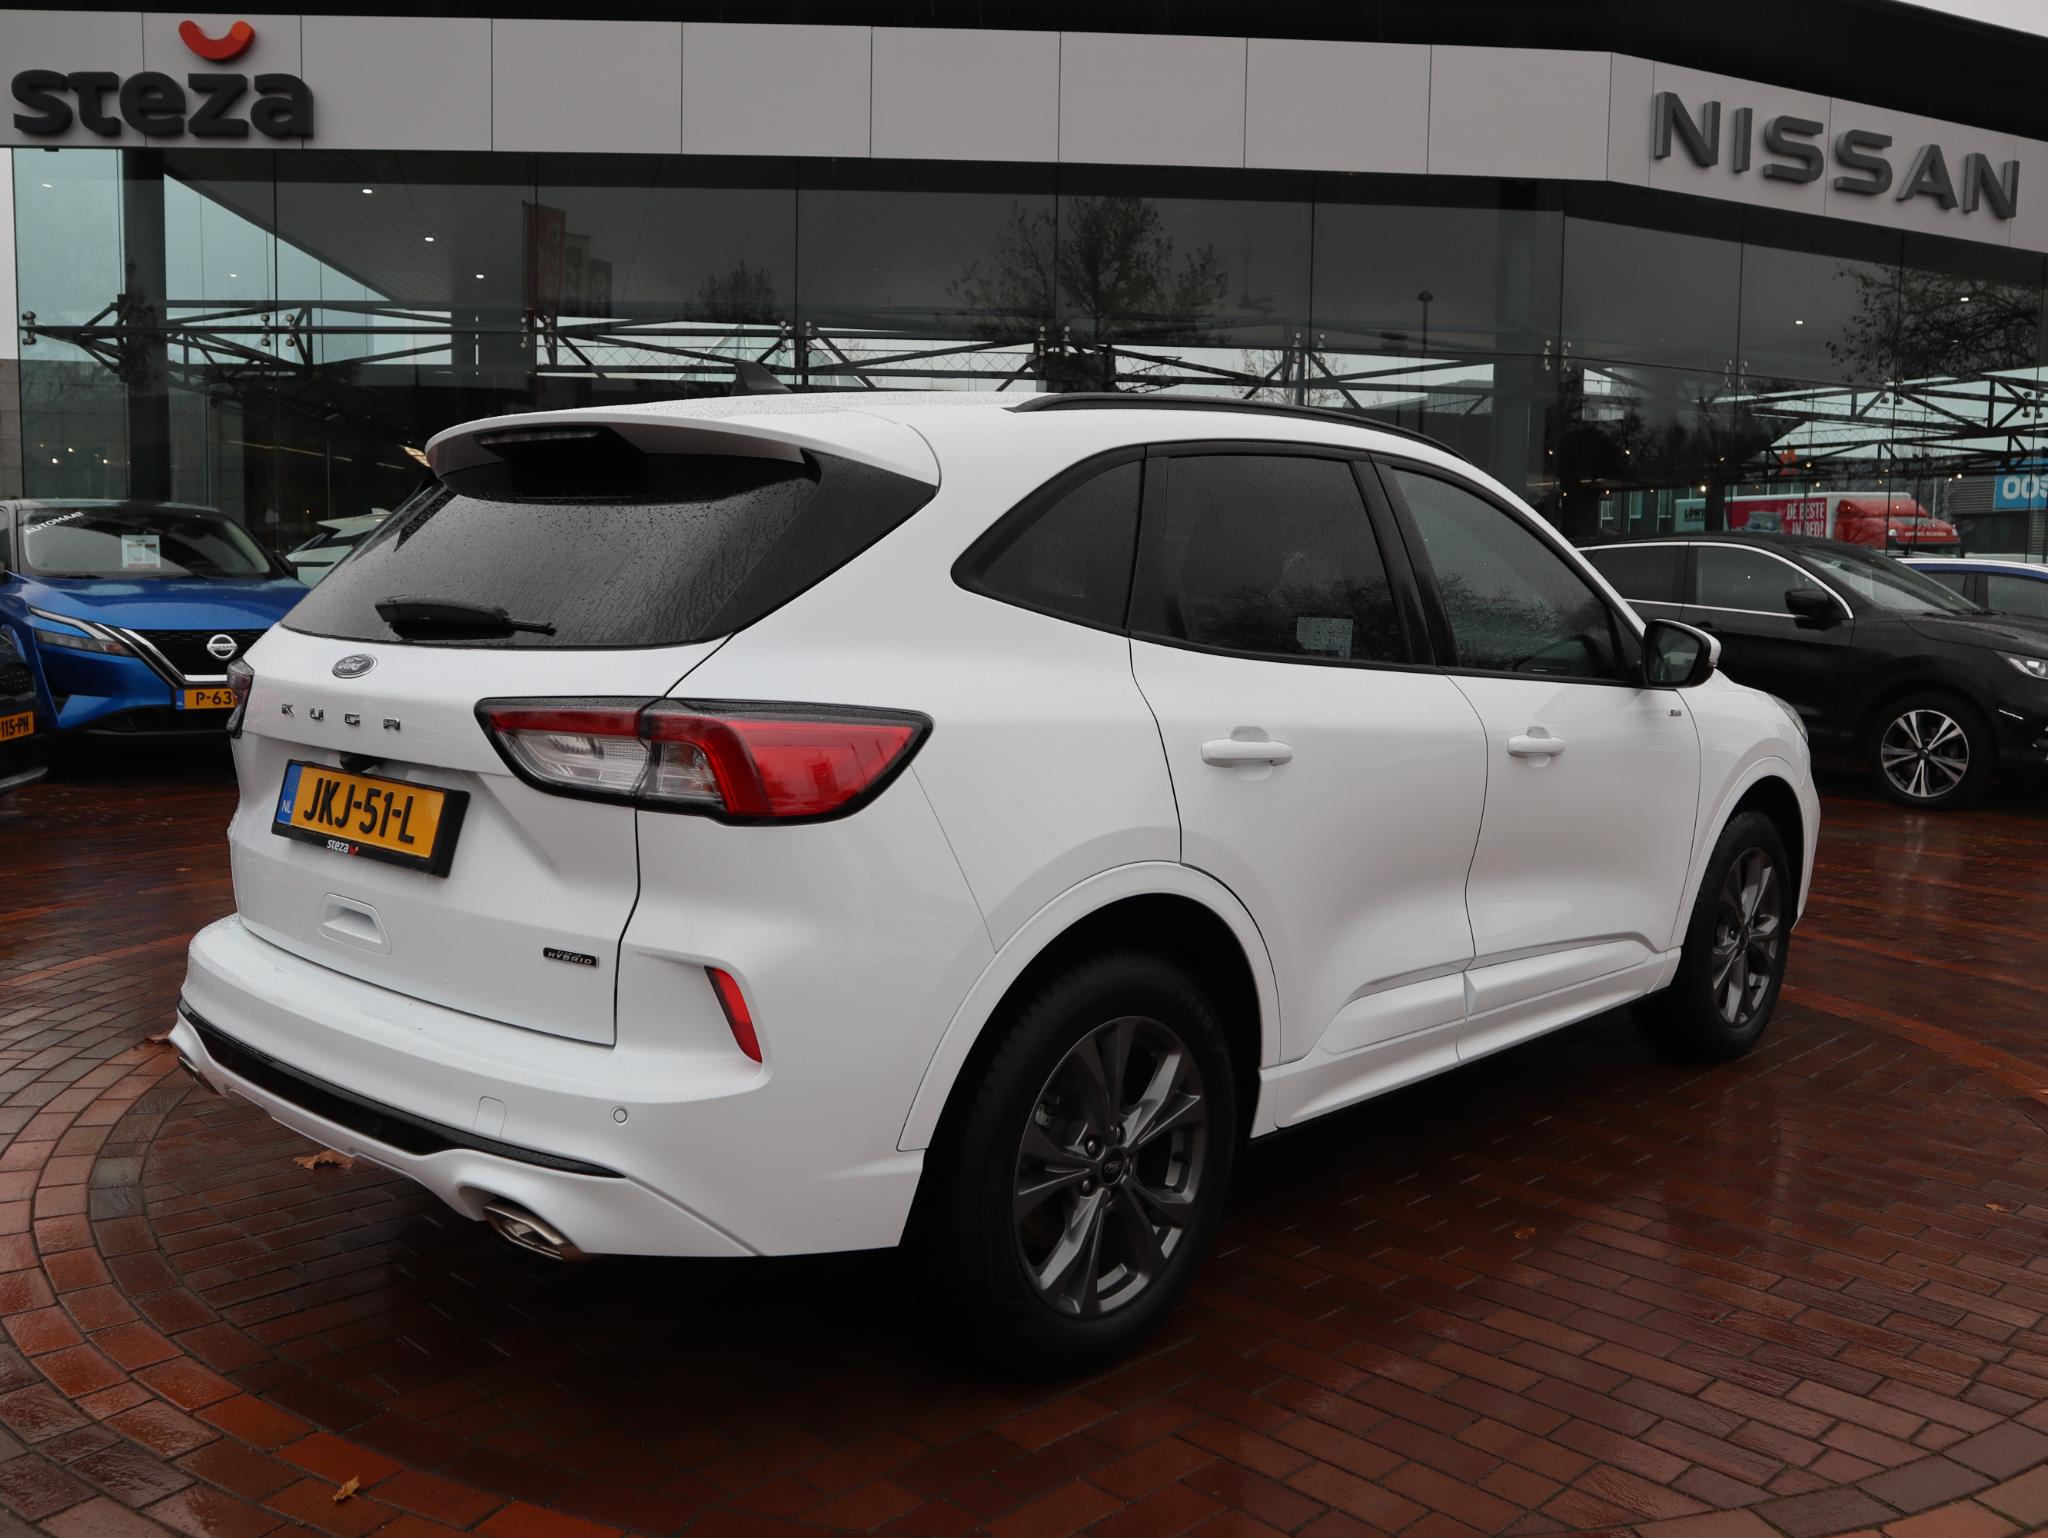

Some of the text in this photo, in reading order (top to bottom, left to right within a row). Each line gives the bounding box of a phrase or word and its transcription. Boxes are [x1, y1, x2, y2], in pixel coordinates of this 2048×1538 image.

[11, 70, 315, 139] steza
[1655, 91, 2021, 221] NISSAN
[1787, 501, 1825, 520] DE BESTE
[24, 511, 84, 535] AUTOMAAT
[195, 691, 232, 706] P-63
[281, 704, 401, 731] KUGA
[281, 777, 416, 844] NL JKJ-51-L
[326, 839, 349, 854] steza
[548, 951, 592, 965] HYBRID
